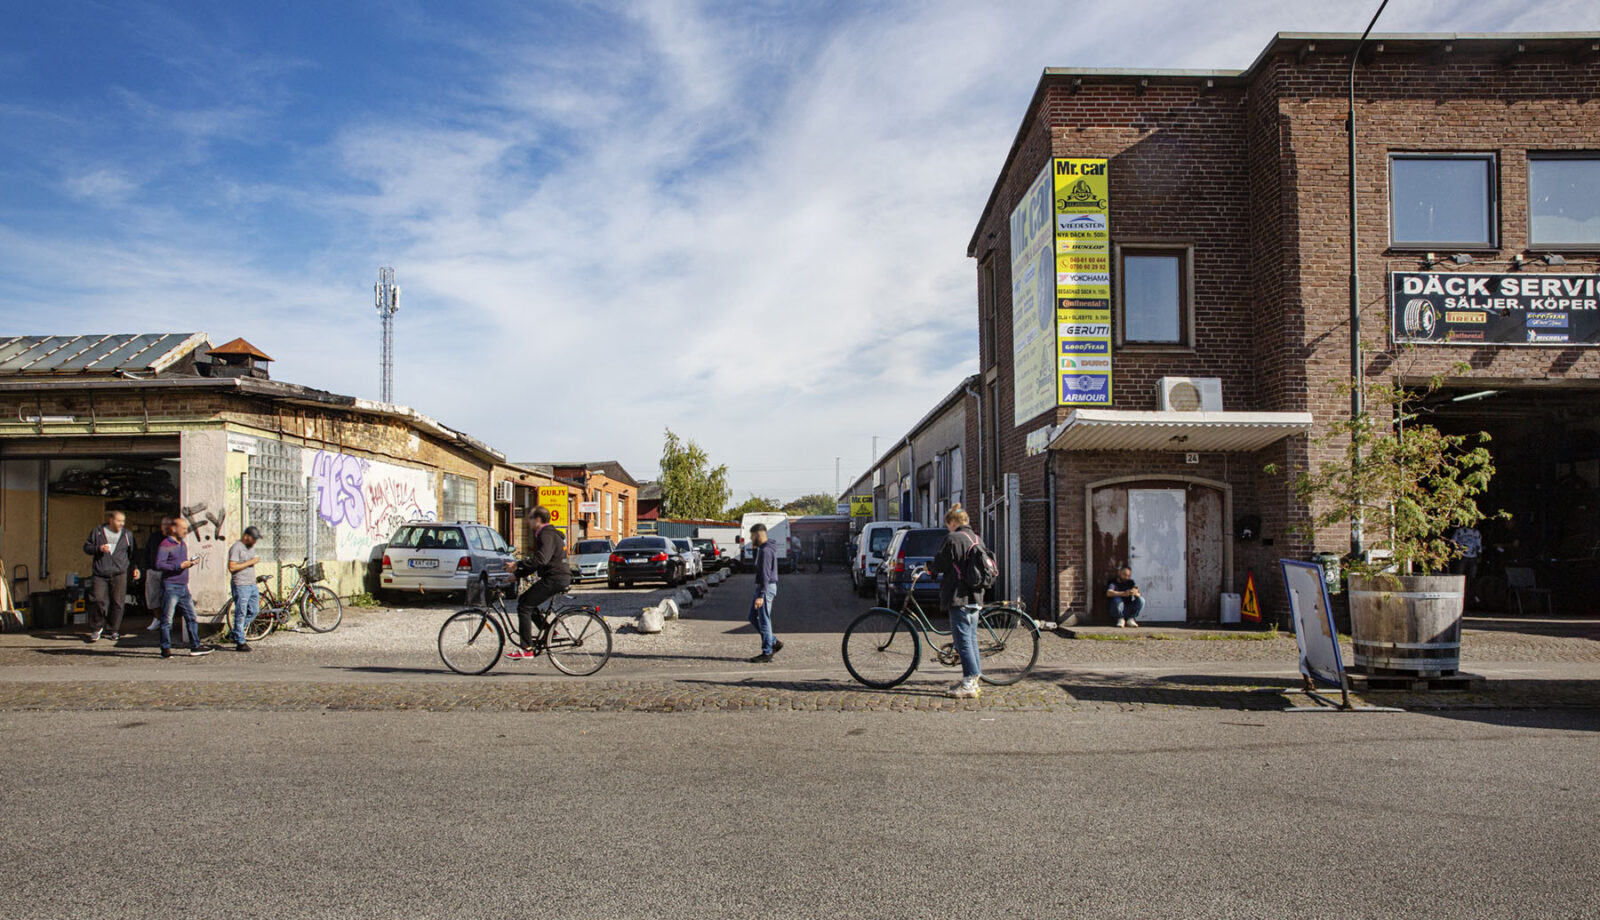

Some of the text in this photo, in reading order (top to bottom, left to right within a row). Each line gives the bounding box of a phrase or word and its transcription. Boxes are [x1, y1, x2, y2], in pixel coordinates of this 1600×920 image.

[1056, 161, 1106, 176] Mr. car
[1403, 275, 1600, 296] DÄCK SERVI
[1530, 297, 1597, 310] KÖPER
[1066, 326, 1109, 335] GERUTTI
[1065, 343, 1105, 352] GOODYEAR
